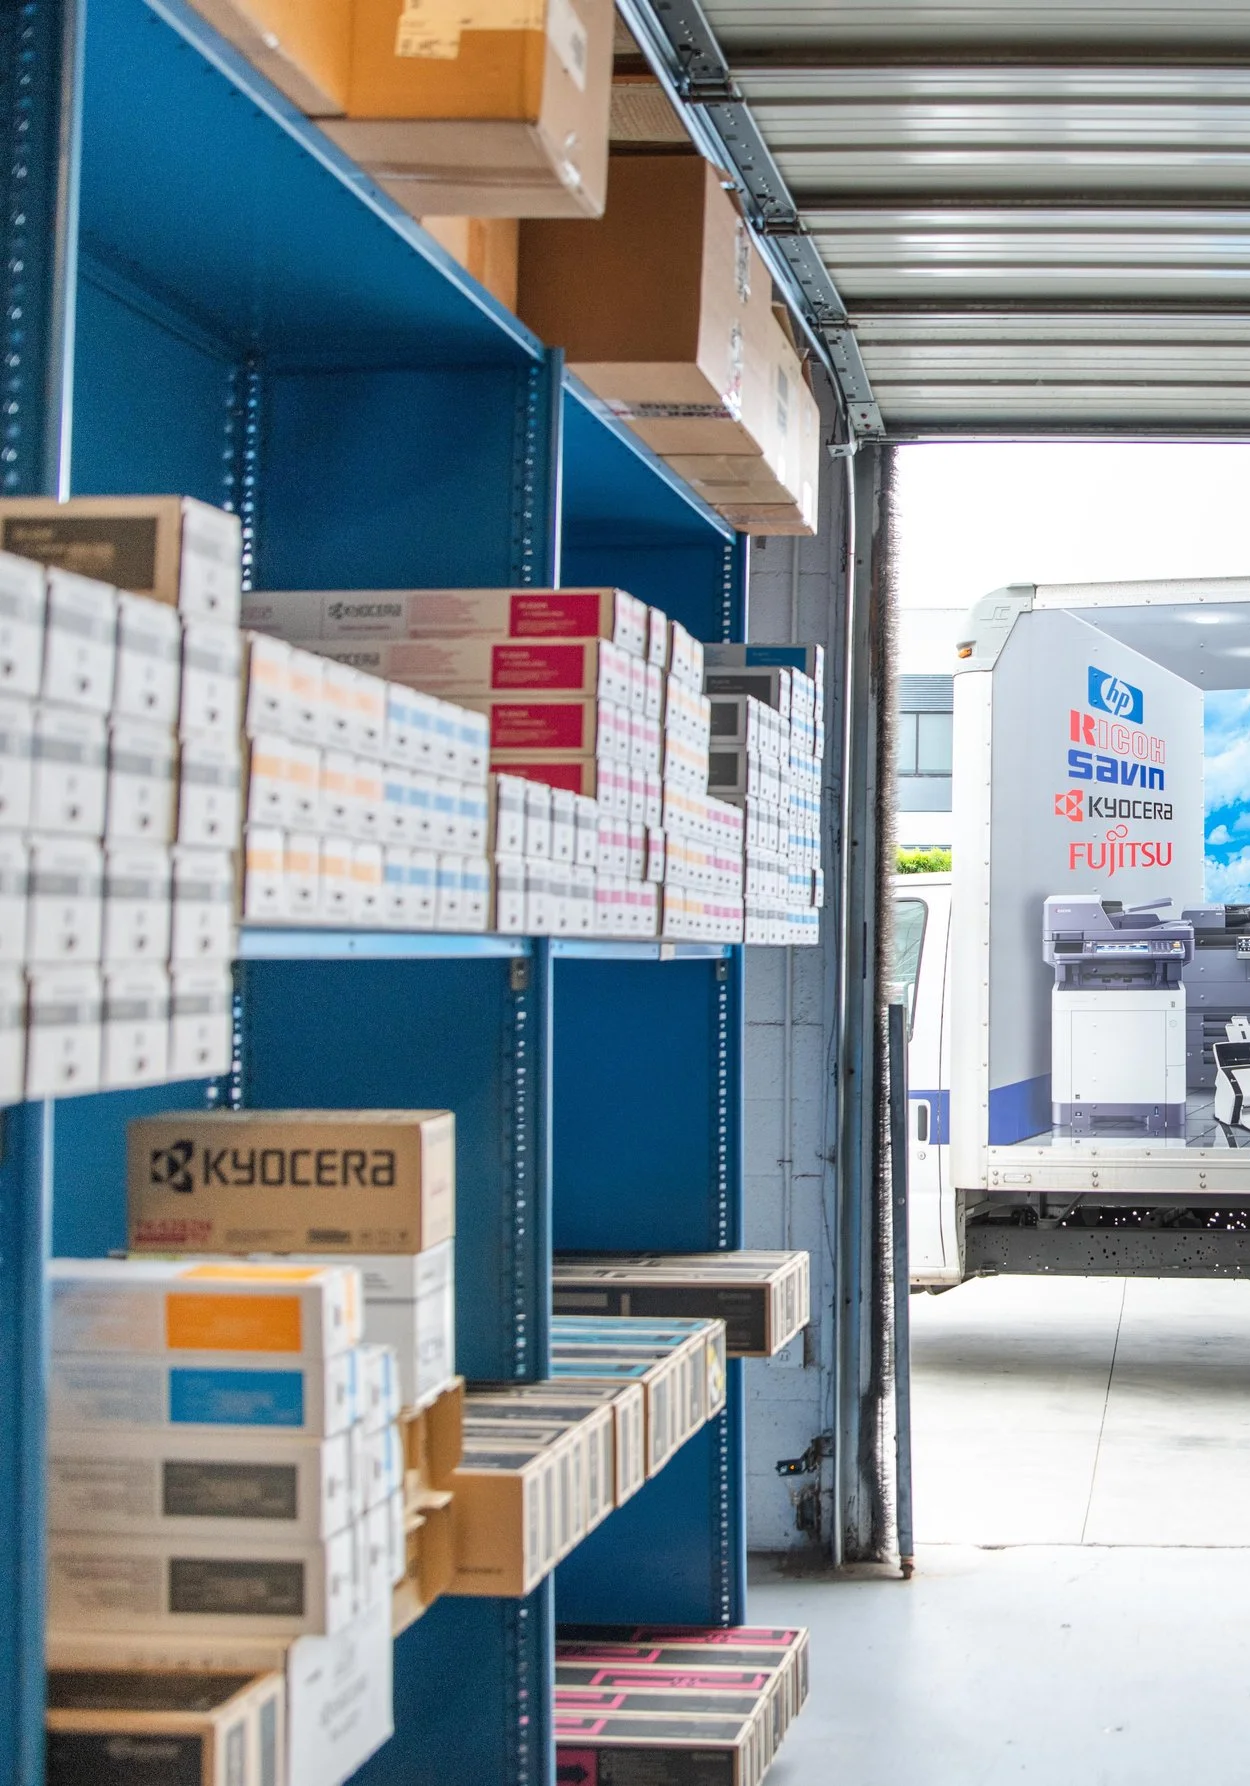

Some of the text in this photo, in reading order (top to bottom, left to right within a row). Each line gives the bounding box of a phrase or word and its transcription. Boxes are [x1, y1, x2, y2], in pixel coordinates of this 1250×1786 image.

[1070, 709, 1165, 764] RICOH
[1088, 796, 1173, 821] KYOCERA
[1069, 840, 1173, 877] FUJITSU
[203, 1149, 396, 1188] KYOCERA
